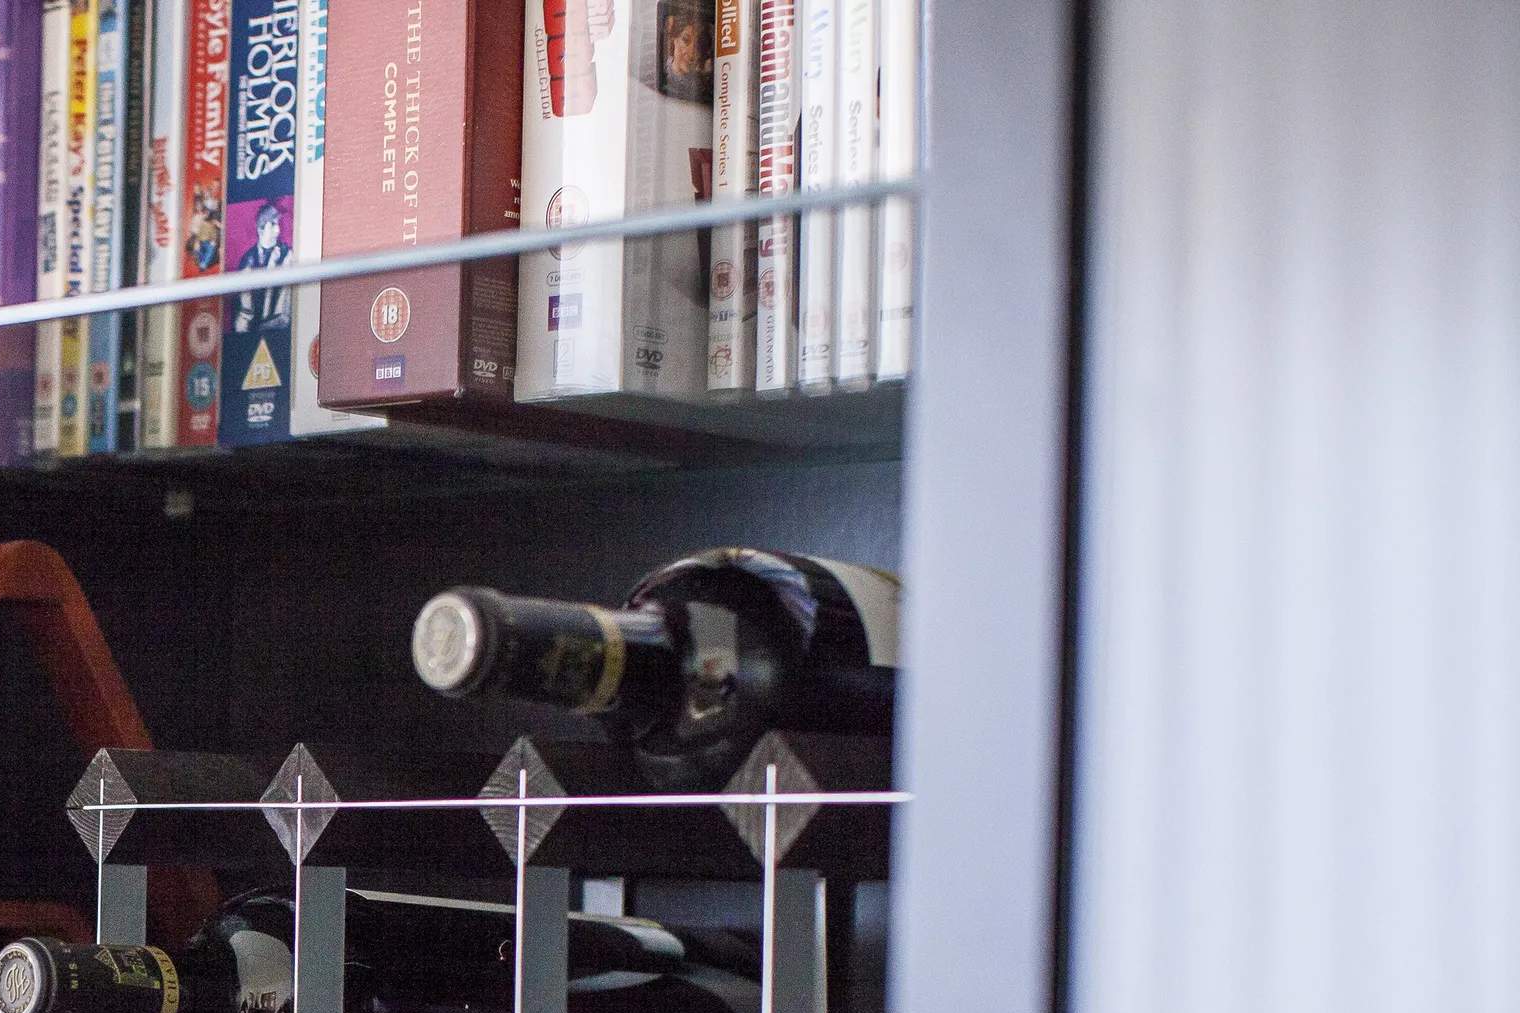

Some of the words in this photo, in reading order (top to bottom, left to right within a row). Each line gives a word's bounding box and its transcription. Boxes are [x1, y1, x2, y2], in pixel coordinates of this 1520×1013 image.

[406, 1, 422, 65] THE
[71, 38, 88, 103] Peter
[245, 15, 273, 181] HOLMES
[535, 28, 551, 120] COLLECTION
[718, 62, 732, 129] Complete
[69, 112, 87, 176] Kay's
[201, 61, 227, 166] Family
[382, 62, 398, 193] COMPLETE
[404, 70, 421, 164] THICK
[808, 105, 822, 176] Series
[848, 100, 862, 172] Series
[718, 135, 730, 176] Series
[403, 170, 419, 209] OF
[68, 185, 86, 274] Special
[402, 215, 418, 245] IT
[382, 304, 399, 325] 18
[376, 366, 401, 380] BBC
[473, 359, 498, 371] DVD
[636, 347, 664, 362] DVD
[765, 314, 776, 384] GRANADA
[248, 402, 275, 416] DVD
